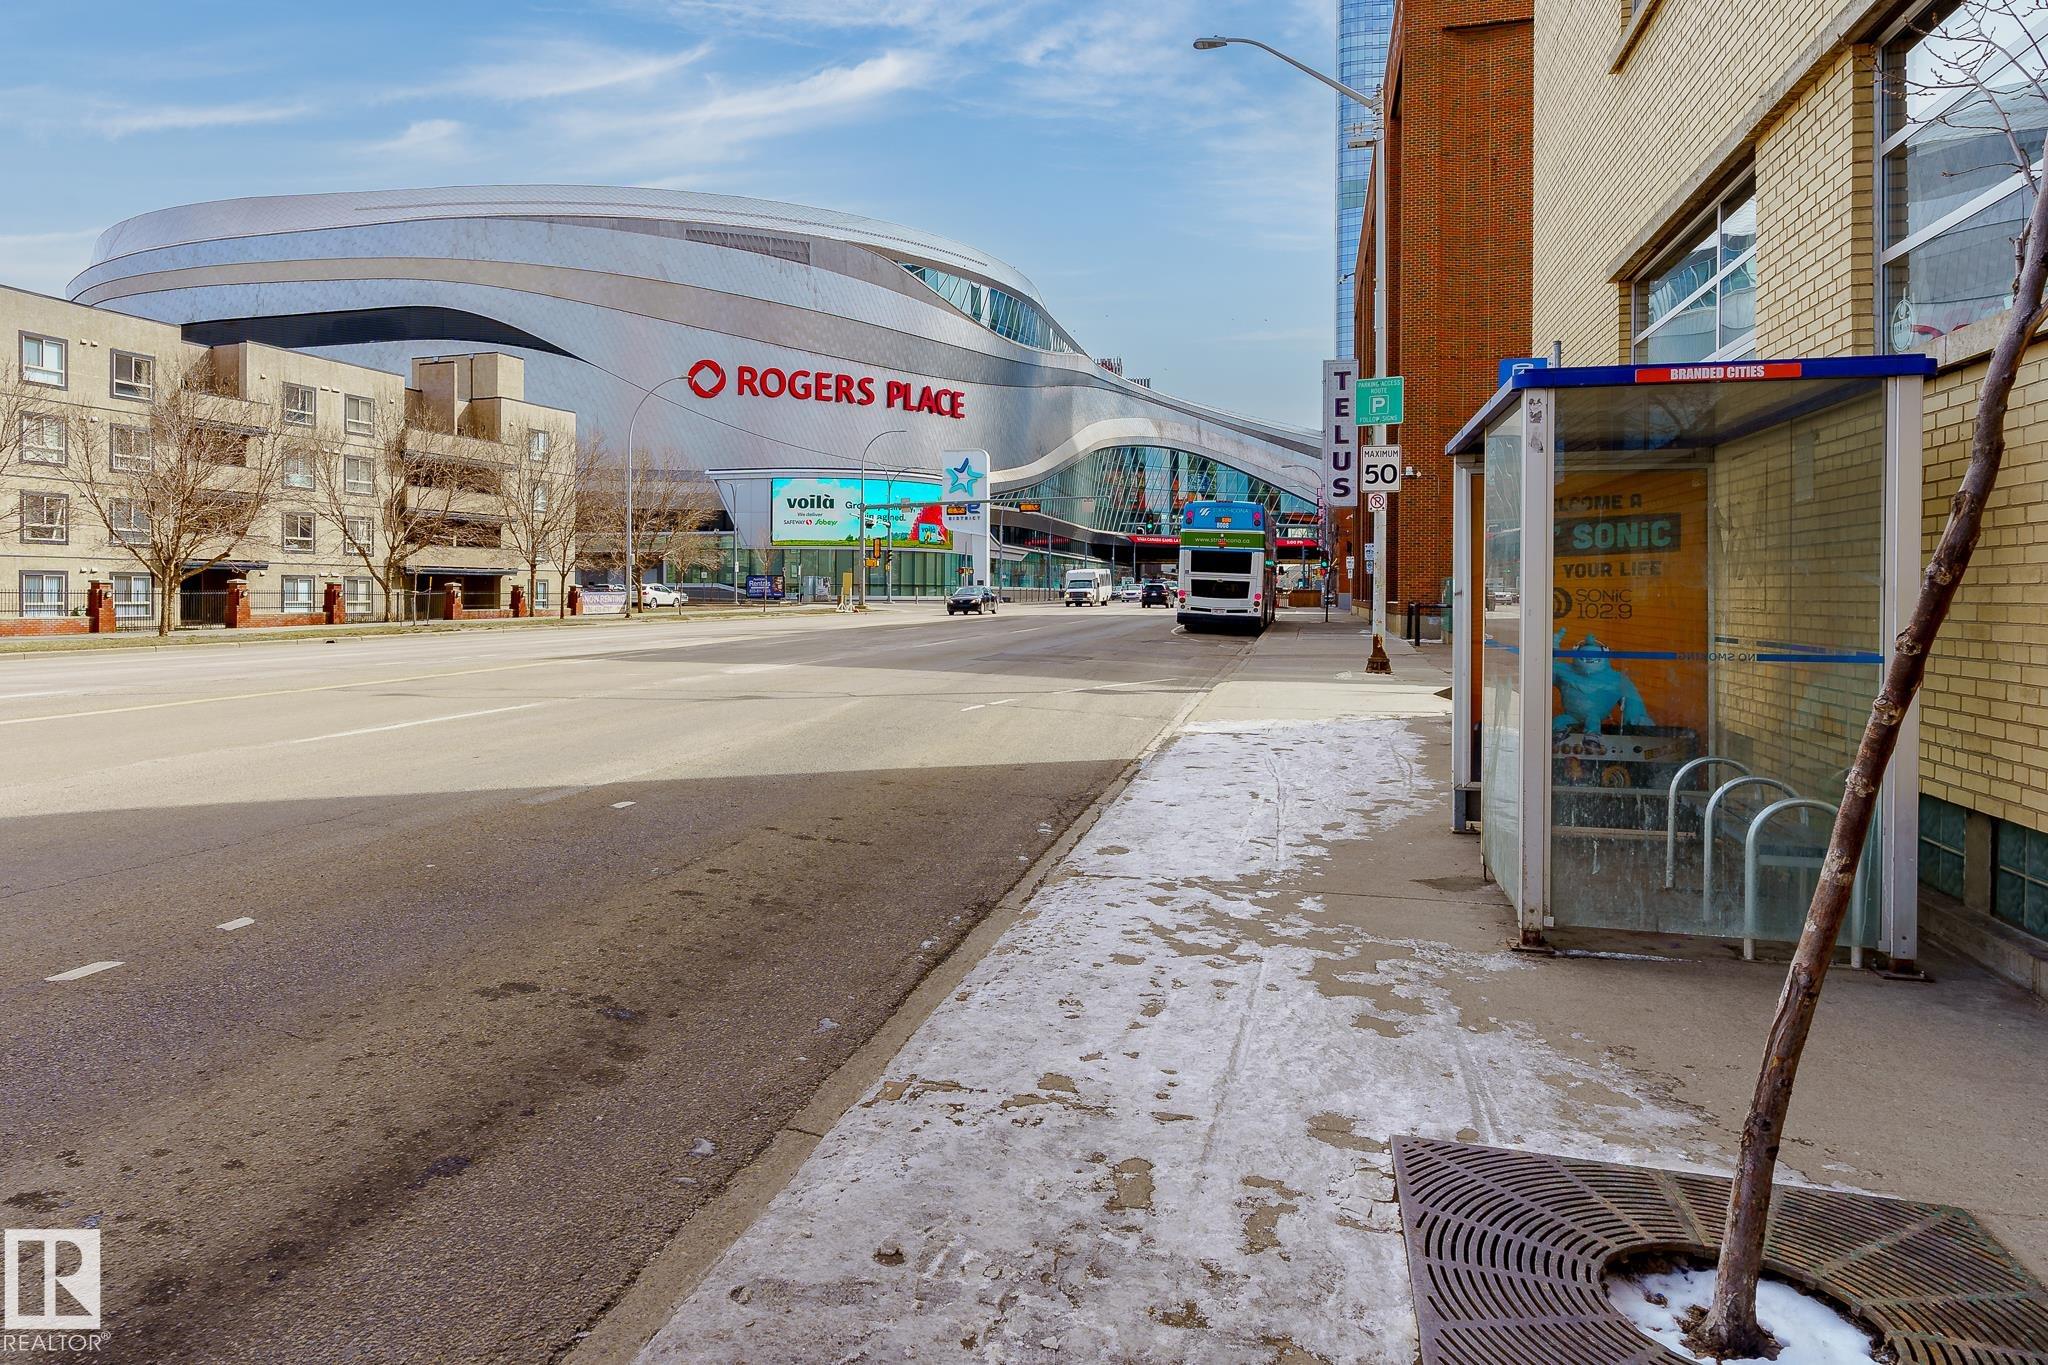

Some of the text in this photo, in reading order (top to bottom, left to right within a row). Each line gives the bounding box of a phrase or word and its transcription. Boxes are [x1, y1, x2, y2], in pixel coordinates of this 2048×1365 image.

[1670, 365, 1766, 380] BRANDED CITIES
[737, 365, 966, 419] ROGERS PLACE
[1372, 397, 1386, 413] P
[1332, 370, 1351, 498] TELUS
[1364, 450, 1399, 459] MAXIMUM
[1364, 463, 1398, 485] 50
[787, 494, 834, 509] voilà
[1554, 494, 1623, 511] ELCOME
[1195, 536, 1250, 544] www.strathcona.ca
[1563, 560, 1662, 578] YOUR LIFE
[1577, 603, 1633, 619] 102.9
